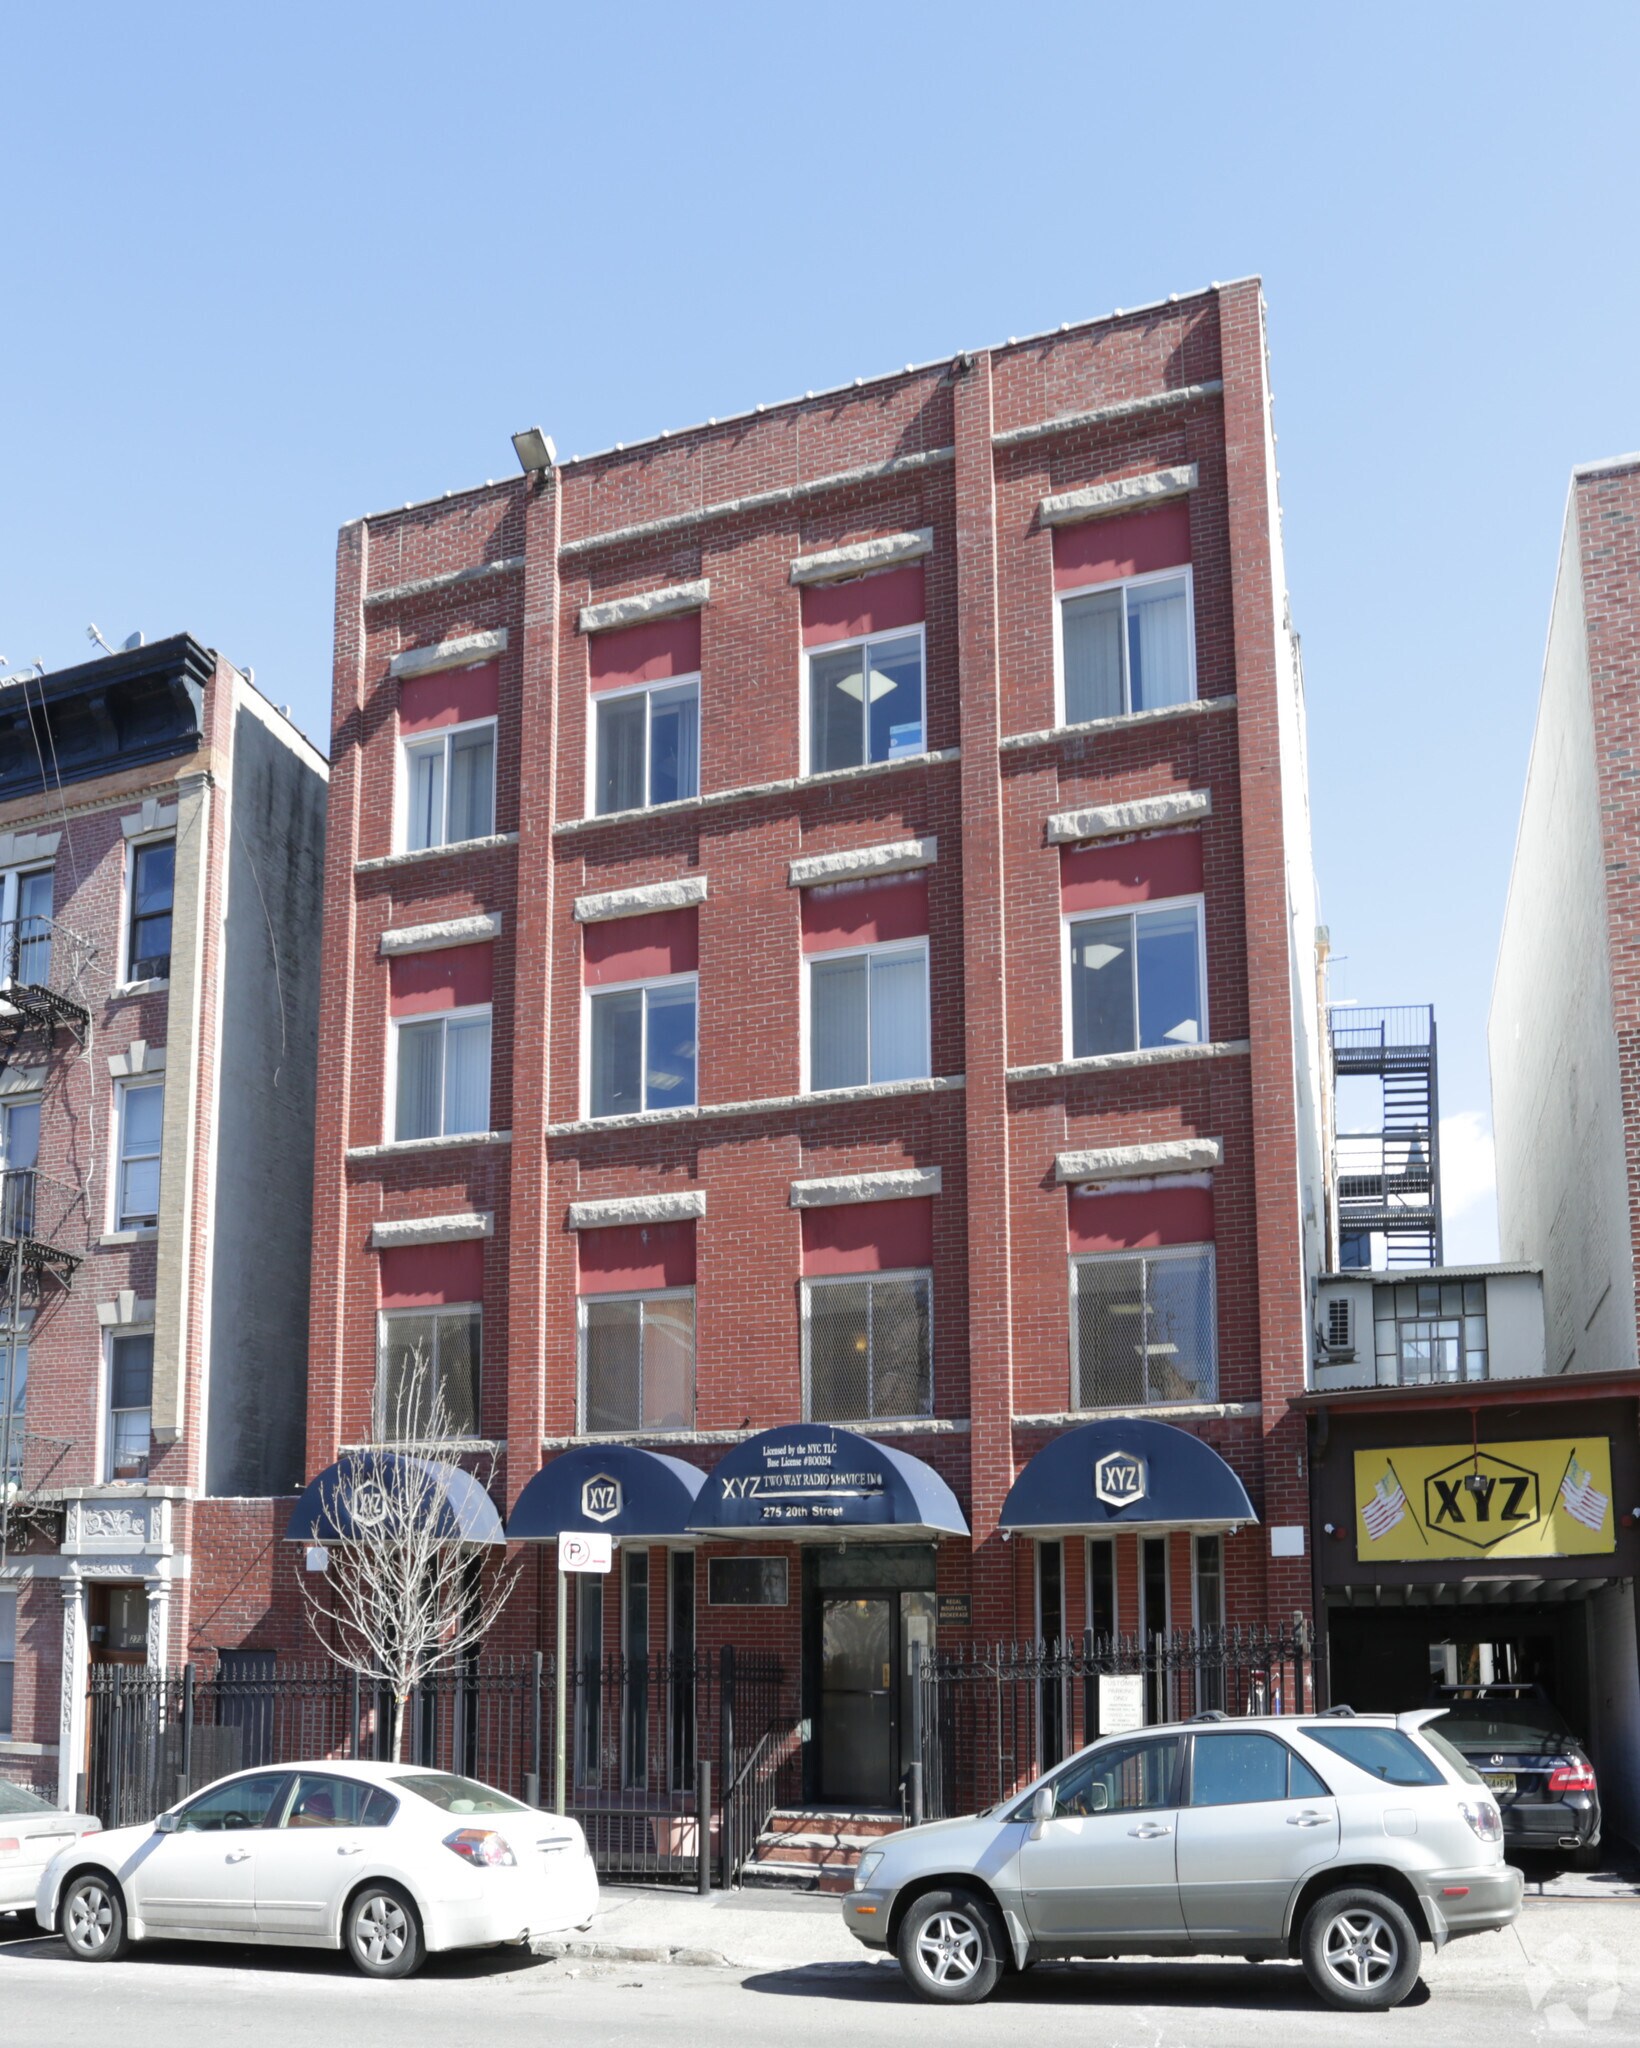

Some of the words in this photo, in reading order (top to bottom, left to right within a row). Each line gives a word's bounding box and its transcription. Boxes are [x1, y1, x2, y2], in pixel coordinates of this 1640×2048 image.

[763, 1445, 787, 1456] Licensed
[788, 1445, 796, 1456] by
[797, 1444, 806, 1454] the
[807, 1443, 821, 1454] NYC
[823, 1443, 838, 1454] TLC
[767, 1458, 780, 1468] Base
[781, 1456, 802, 1467] License
[722, 1476, 761, 1499] XYZ
[764, 1475, 782, 1487] TWO
[783, 1474, 802, 1486] WAY
[803, 1474, 830, 1486] RADIO
[830, 1473, 866, 1485] SERVICE
[1105, 1466, 1137, 1491] XYZ
[359, 1493, 382, 1514] XYZ
[590, 1486, 616, 1509] XYZ
[1433, 1477, 1530, 1523] XYZ
[763, 1506, 782, 1518] 275
[785, 1506, 808, 1518] 20th
[812, 1505, 844, 1517] Street
